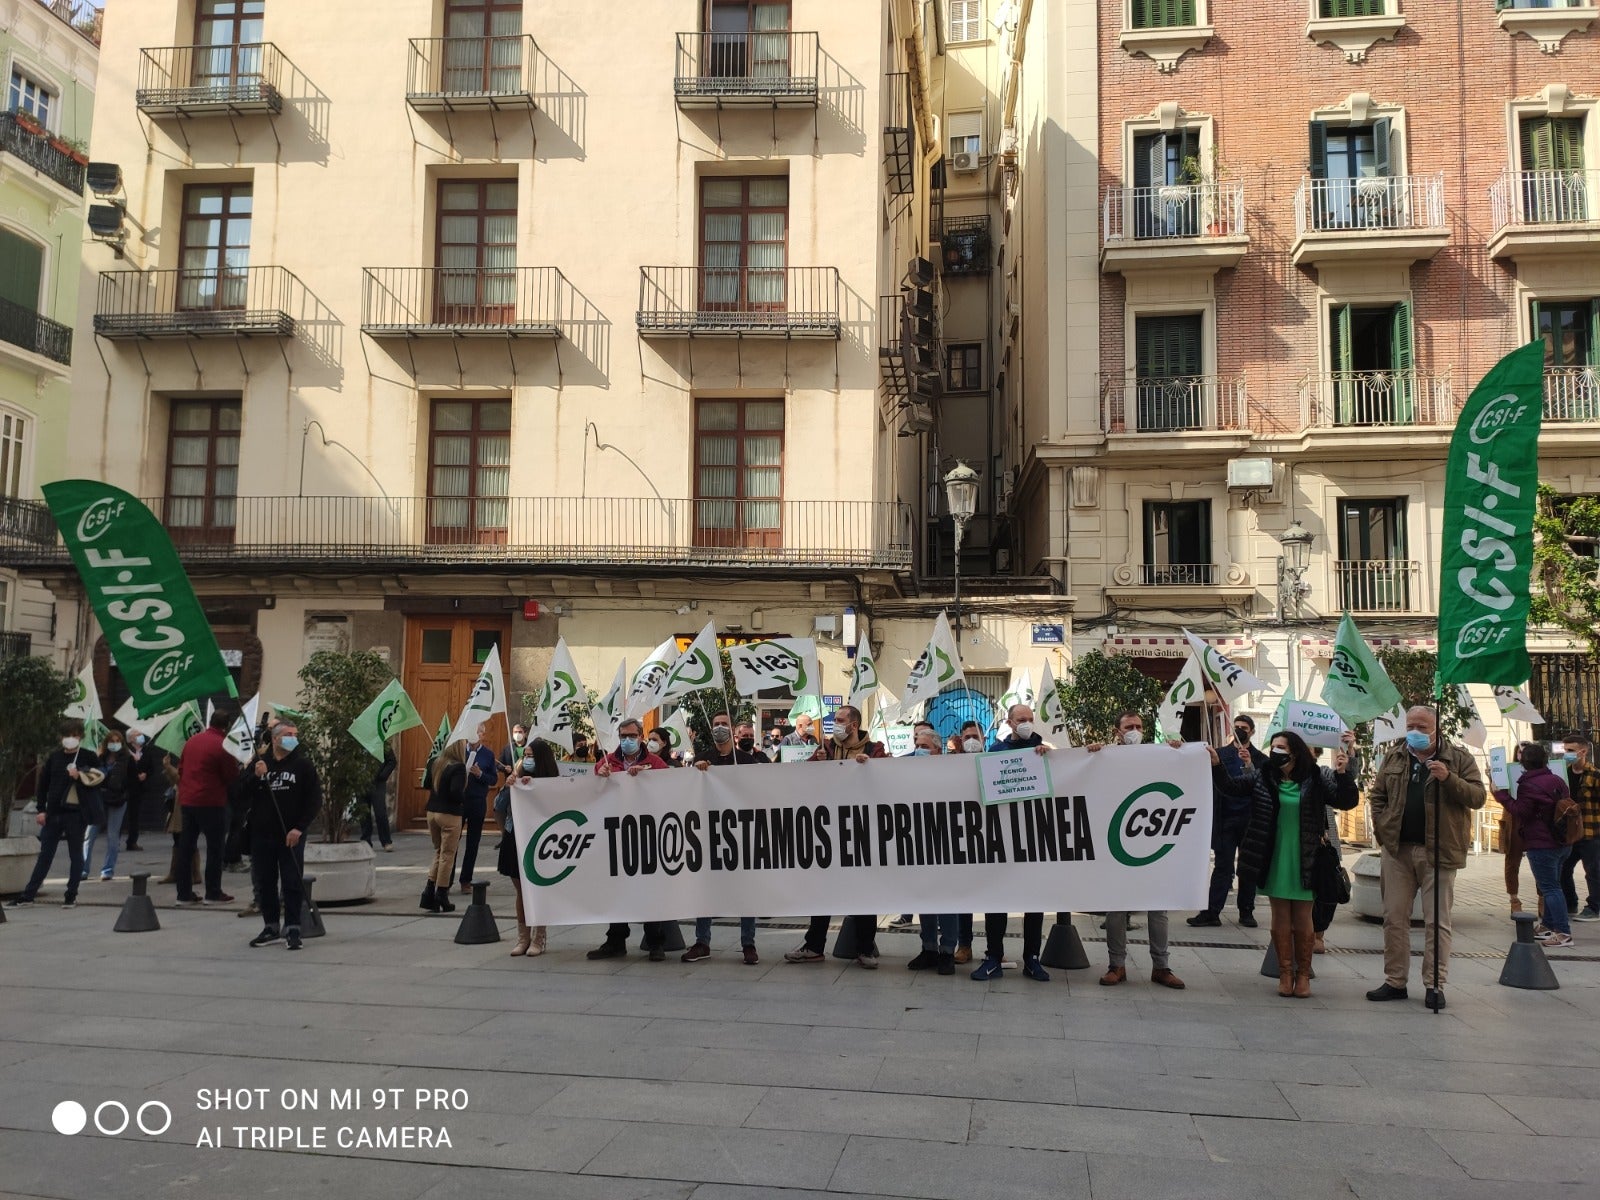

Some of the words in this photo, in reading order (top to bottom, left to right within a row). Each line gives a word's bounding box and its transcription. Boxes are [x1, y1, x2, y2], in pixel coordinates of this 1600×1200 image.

[1121, 648, 1153, 656] Estrella
[1154, 648, 1184, 657] Galicia
[1316, 712, 1335, 720] SOY
[992, 775, 1037, 786] EMERGENCIAS
[997, 785, 1035, 794] SANITARIAS
[1124, 807, 1198, 838] CSIF
[604, 810, 702, 877] TOD@S
[708, 805, 832, 872] ESTAMOS
[837, 804, 871, 867] EN
[876, 800, 1007, 866] PRIMERA
[1009, 795, 1096, 863] LINEA
[538, 833, 596, 860] CSIF
